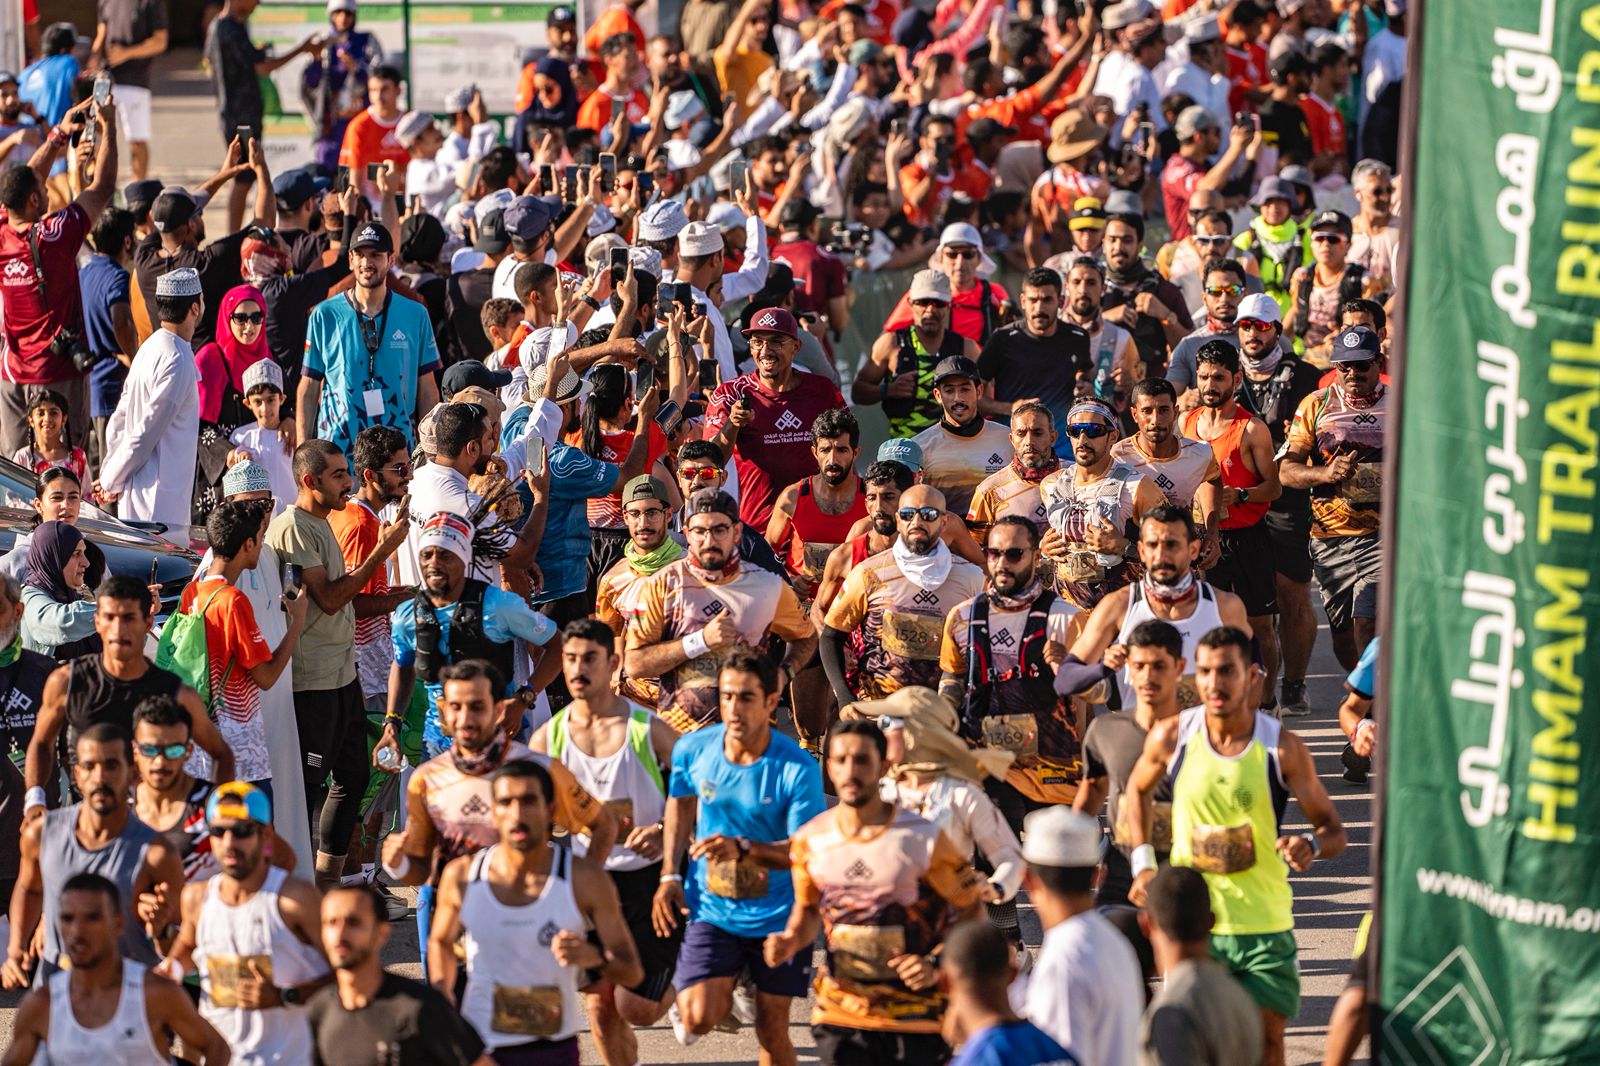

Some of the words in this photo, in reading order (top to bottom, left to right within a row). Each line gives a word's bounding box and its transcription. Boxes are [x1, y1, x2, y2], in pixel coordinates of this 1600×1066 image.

[1490, 132, 1541, 329] همم
[884, 445, 912, 454] T100
[1477, 339, 1530, 555] للجري
[1537, 318, 1600, 545] TRAIL
[896, 628, 928, 645] 1528
[990, 731, 1024, 746] 1369
[1450, 570, 1526, 828] الجبلي
[1523, 563, 1590, 844] HIMAM
